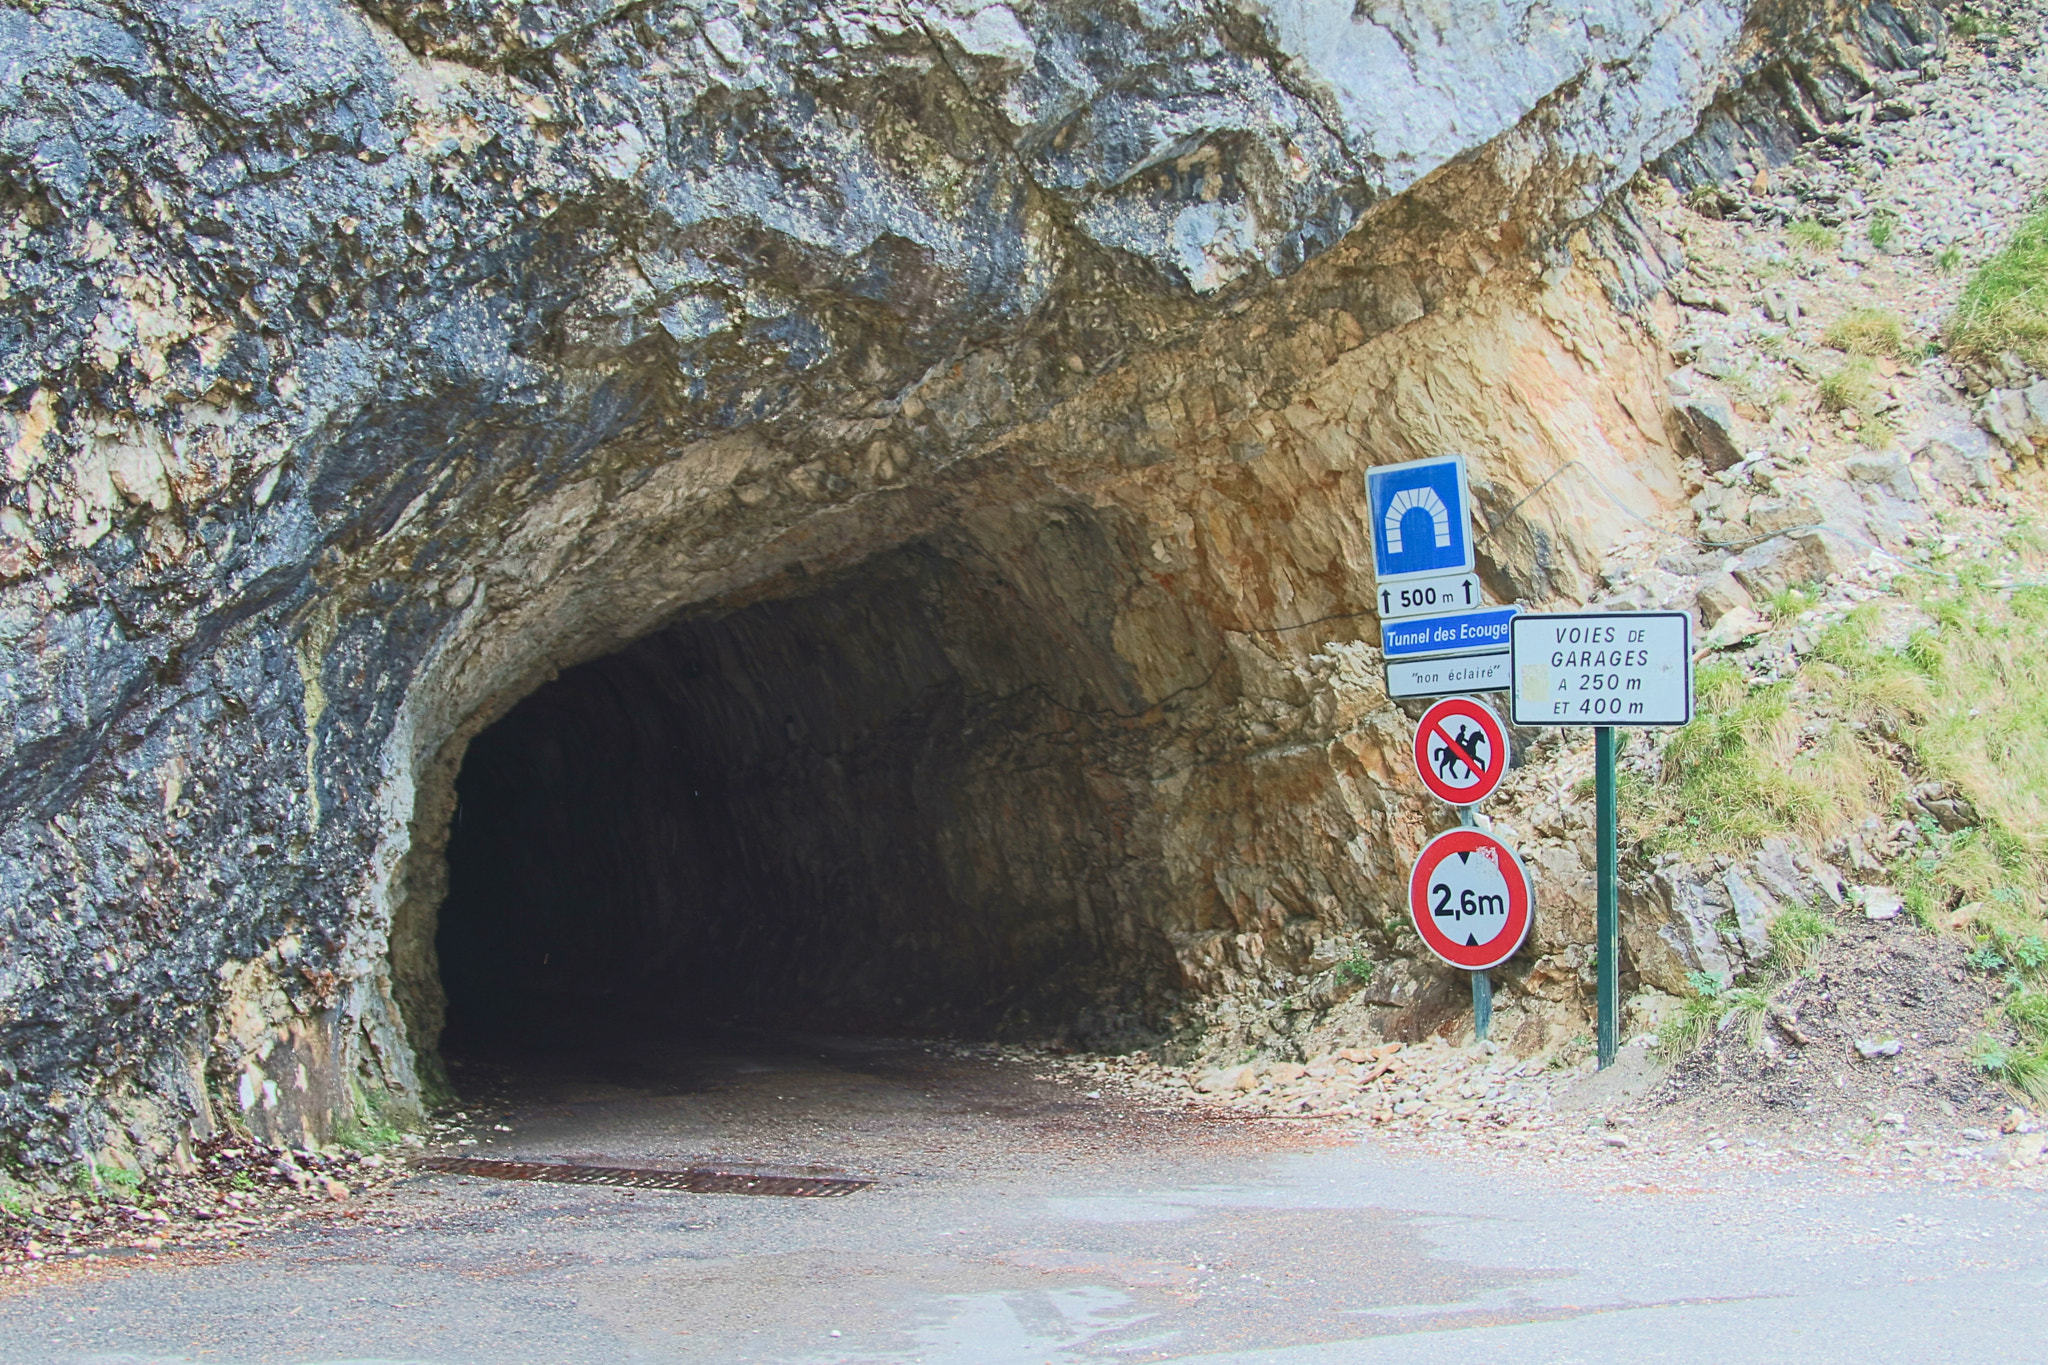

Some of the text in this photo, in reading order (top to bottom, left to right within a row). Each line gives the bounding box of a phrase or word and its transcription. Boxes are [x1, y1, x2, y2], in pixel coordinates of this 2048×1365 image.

[1401, 588, 1454, 607] 500 m
[1388, 628, 1430, 647] Tunnel
[1434, 626, 1456, 642] des
[1556, 627, 1645, 643] VOIES DE
[1551, 650, 1648, 668] GARAGES
[1412, 664, 1500, 684] "non éclairé"
[1558, 674, 1642, 692] A 250 m
[1554, 698, 1644, 715] ET 400 m
[1432, 884, 1504, 921] 2,6m
